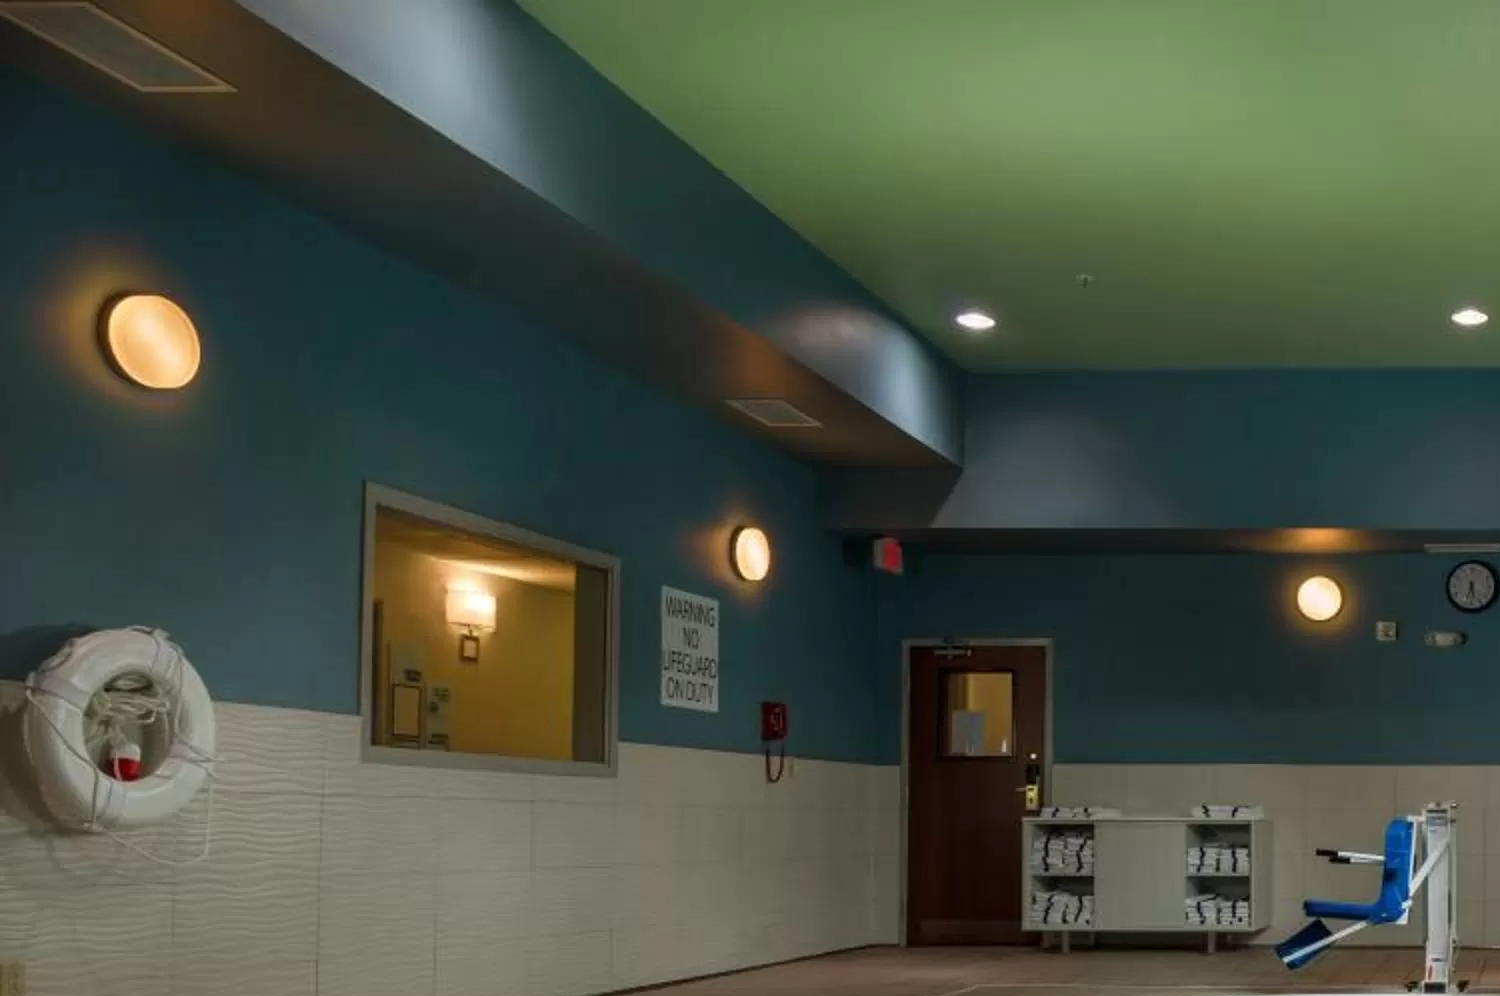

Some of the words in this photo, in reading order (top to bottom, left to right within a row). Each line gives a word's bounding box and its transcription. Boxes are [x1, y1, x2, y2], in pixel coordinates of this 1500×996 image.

[665, 593, 716, 628] WARNING
[683, 625, 701, 650] NO
[664, 651, 717, 679] LIFEGUARD
[666, 677, 684, 702] ON
[686, 681, 715, 705] DUTY
